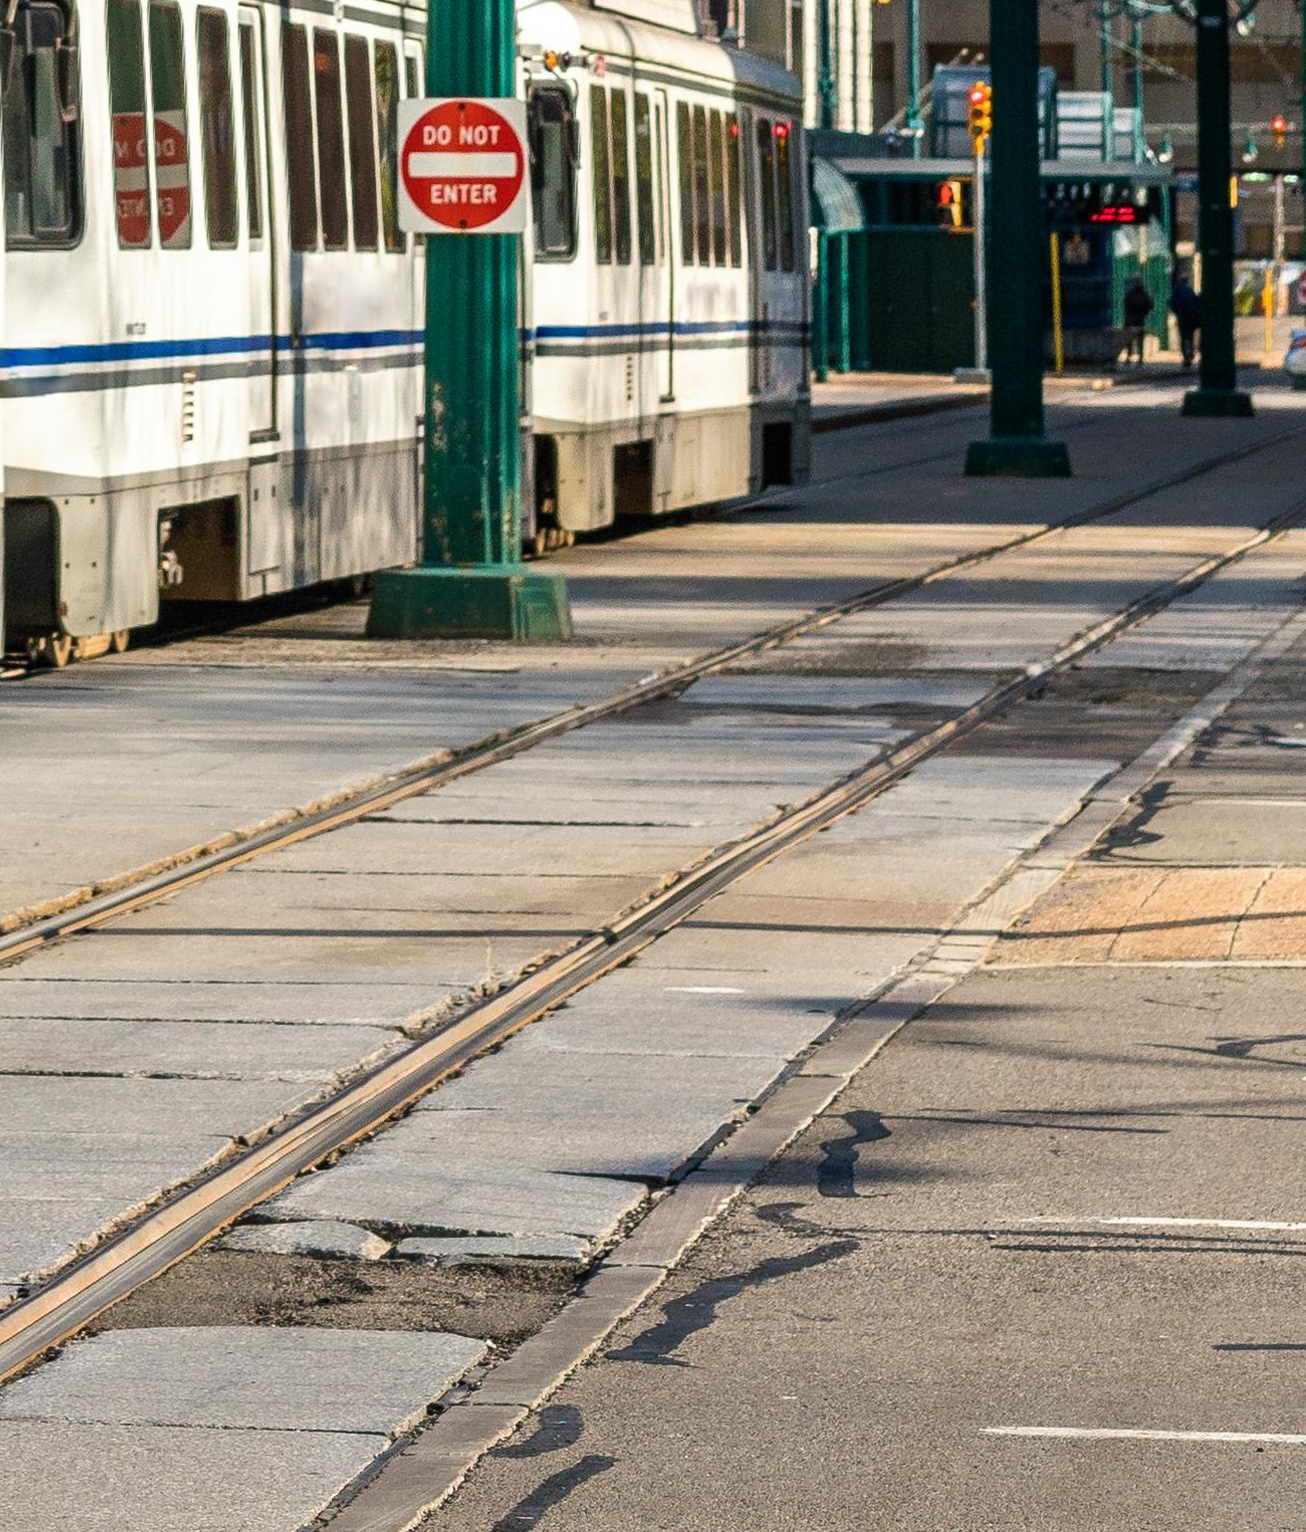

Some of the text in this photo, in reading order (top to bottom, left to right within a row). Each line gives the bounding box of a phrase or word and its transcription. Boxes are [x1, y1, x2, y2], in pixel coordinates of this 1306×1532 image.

[422, 125, 501, 145] DO NOT
[430, 183, 497, 204] ENTER
